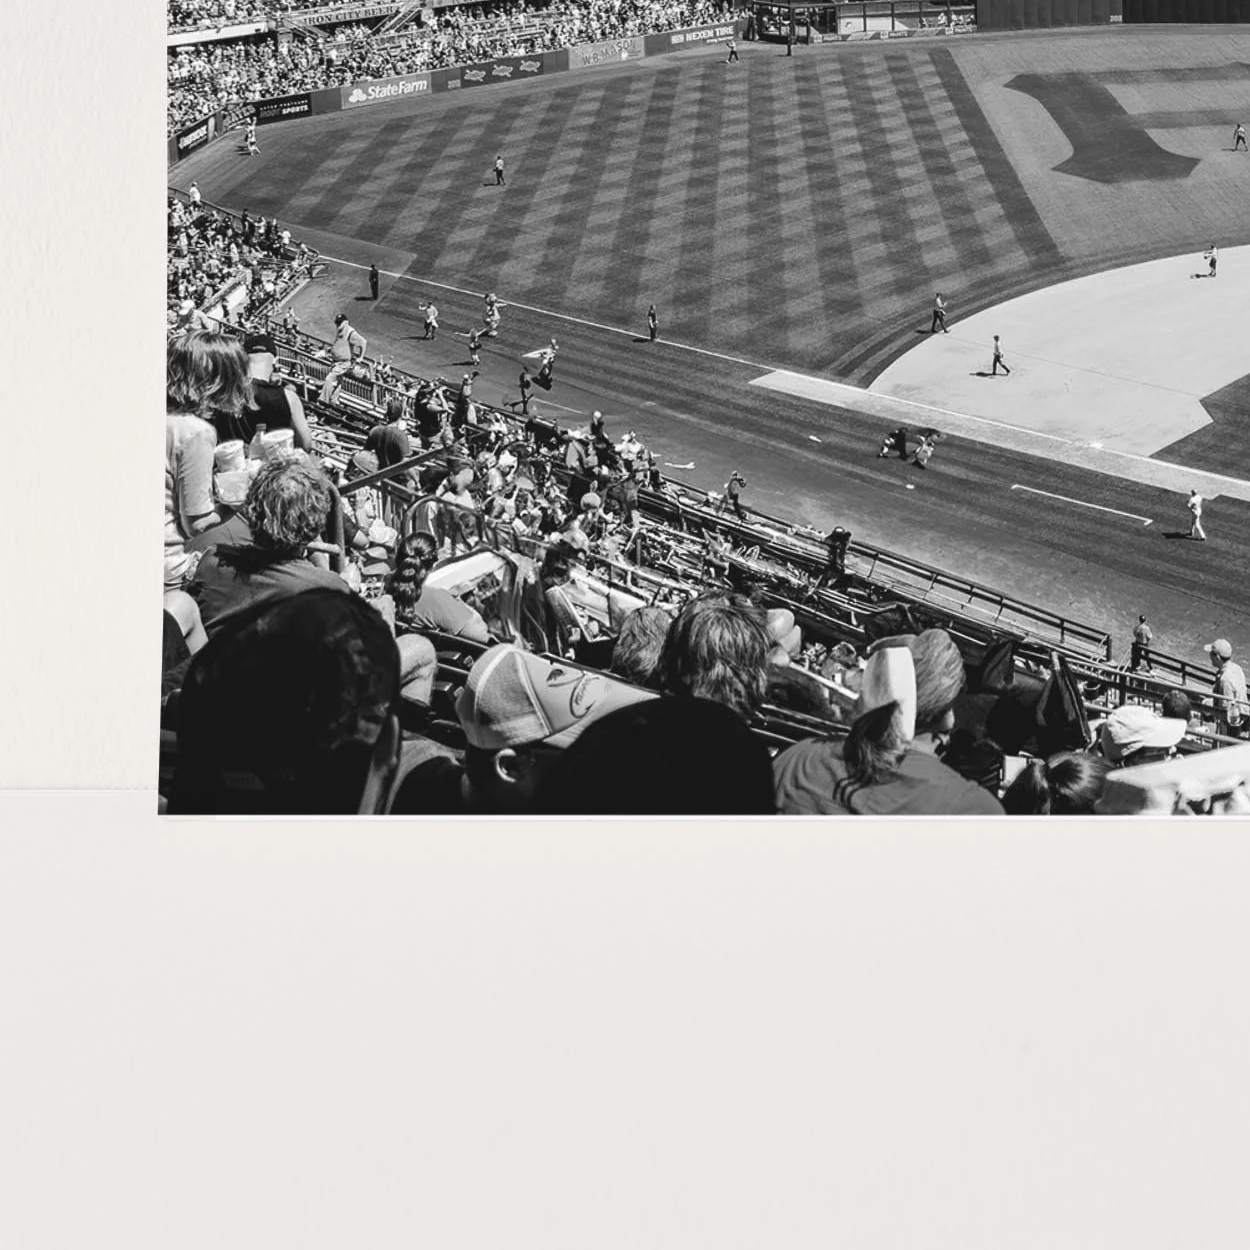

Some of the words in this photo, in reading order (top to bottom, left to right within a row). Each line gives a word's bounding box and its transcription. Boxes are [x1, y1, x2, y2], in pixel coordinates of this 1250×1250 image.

[336, 10, 361, 22] CITY
[364, 5, 394, 17] BEER
[685, 28, 714, 42] NEXEN
[714, 25, 734, 37] TIRE
